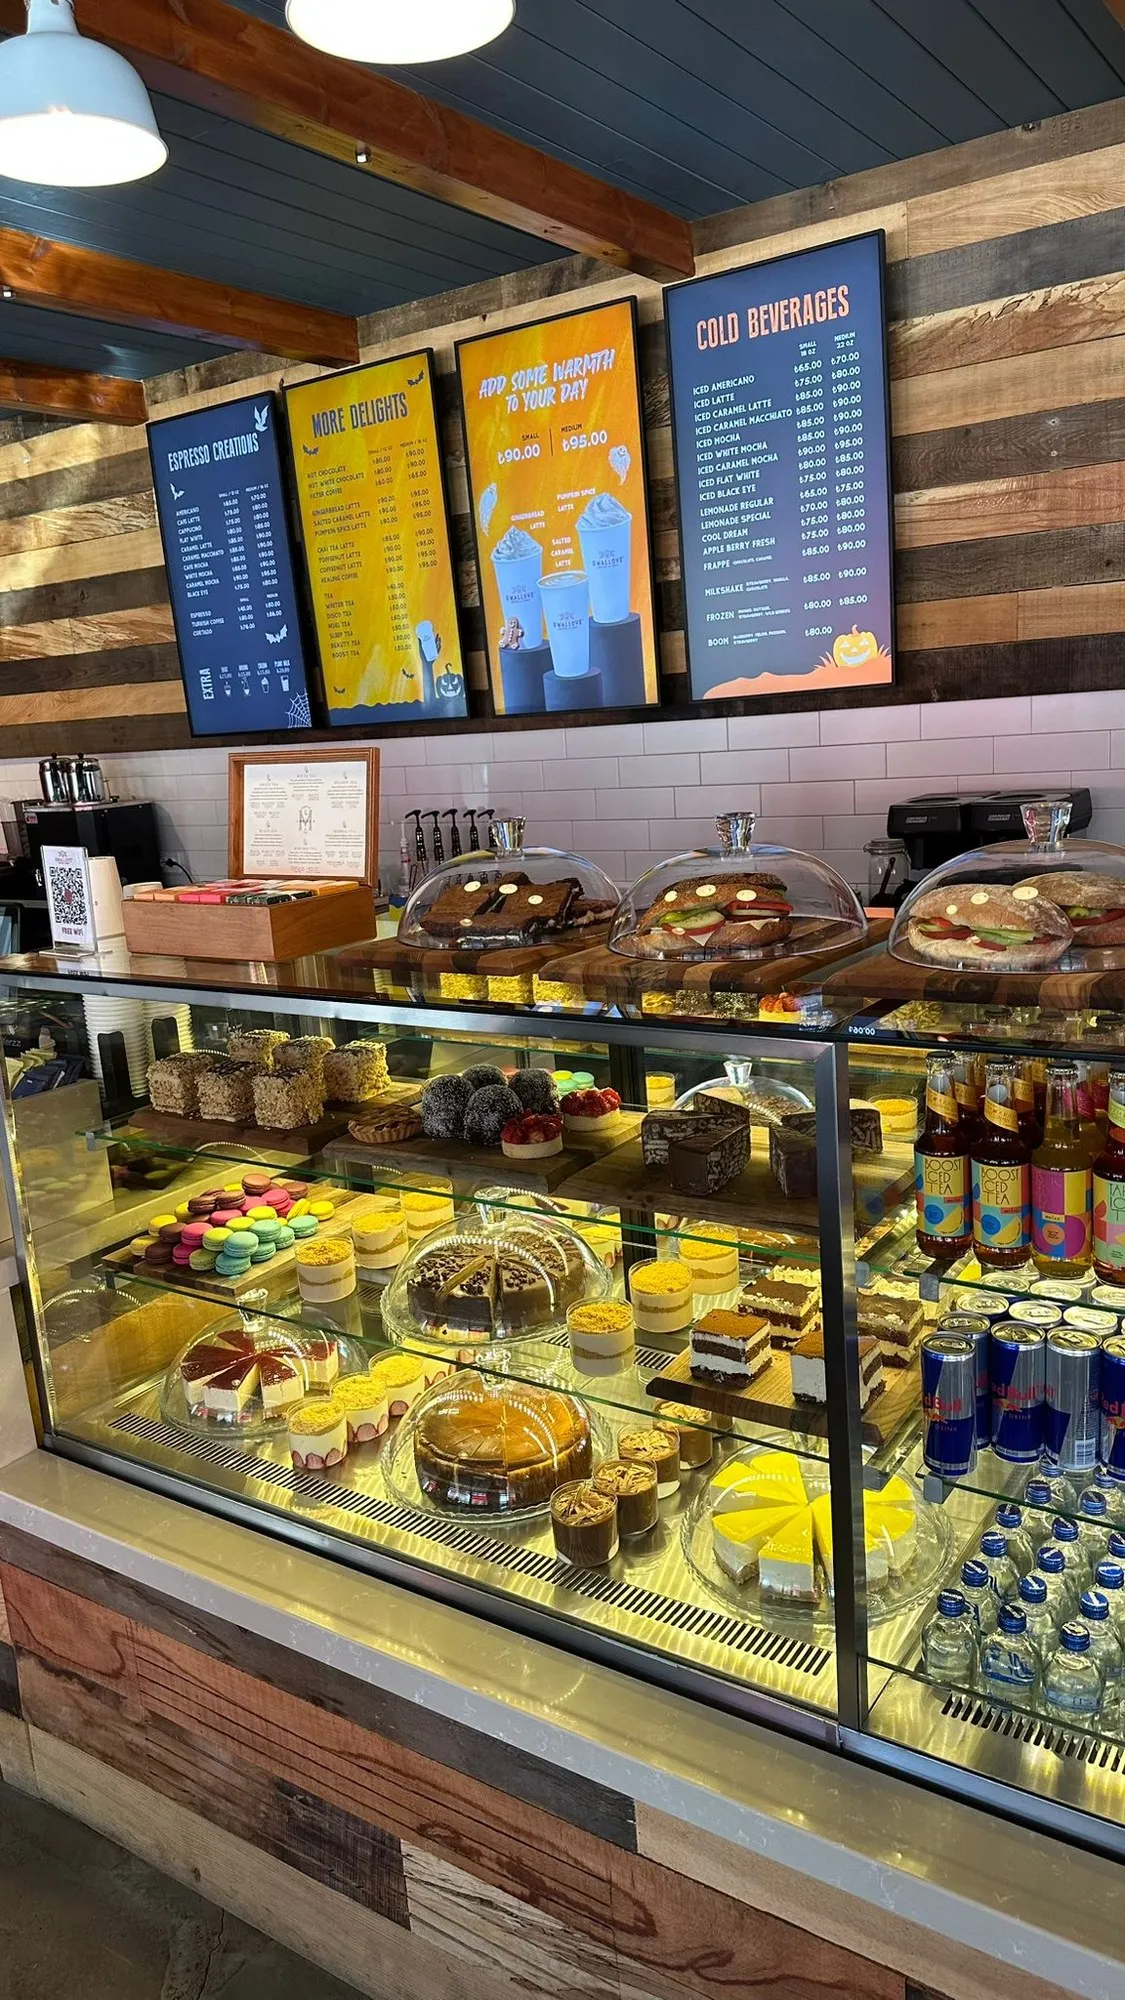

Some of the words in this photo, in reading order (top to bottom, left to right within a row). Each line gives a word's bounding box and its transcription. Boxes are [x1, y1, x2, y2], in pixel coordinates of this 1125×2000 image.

[696, 313, 738, 349] COLD
[748, 285, 849, 338] BEVERAGES
[479, 375, 506, 398] ADD
[511, 364, 548, 391] SOME
[552, 348, 615, 382] WARMTH
[692, 384, 709, 395] ICED
[711, 375, 754, 391] AMERICANO
[794, 359, 822, 373] ₺65.00
[830, 351, 859, 365] ₺70.00
[693, 398, 710, 408] ICED
[711, 392, 734, 405] LATTE
[794, 374, 822, 387] ₺75.00
[831, 366, 860, 379] ₺80.00
[505, 394, 518, 412] TO
[522, 386, 556, 411] YOUR
[560, 378, 588, 403] DAY
[694, 411, 711, 422] ICED
[712, 404, 746, 418] CARAMEL
[748, 398, 771, 410] LATTE
[795, 388, 823, 401] ₺85.00
[832, 380, 860, 393] ₺90.00
[311, 407, 345, 437] MORE
[349, 392, 407, 429] DELIGHTS
[560, 422, 582, 433] MEDIUM
[695, 425, 711, 435] ICED
[713, 418, 747, 431] CARAMEL
[748, 408, 792, 424] MACCHIATO
[796, 402, 823, 414] ₺85.00
[832, 394, 861, 407] ₺90.00
[696, 438, 712, 448] ICED
[714, 432, 740, 445] MOCHA
[796, 416, 824, 428] ₺85.00
[833, 408, 862, 421] ₺90.00
[168, 444, 210, 471] ESPRESSO
[212, 432, 259, 460] CREATIONS
[521, 431, 539, 441] SMALL
[562, 430, 607, 451] ₺95.00
[696, 452, 713, 461] ICED
[715, 446, 738, 458] WHITE
[740, 441, 767, 453] MOCHA
[797, 430, 824, 442] ₺85.00
[833, 422, 862, 435] ₺90.00
[497, 443, 540, 464] ₺90.00
[697, 465, 714, 475] ICED
[715, 458, 749, 471] CARAMEL
[751, 453, 778, 465] MOCHA
[797, 444, 825, 456] ₺90.00
[834, 436, 863, 449] ₺95.00
[698, 478, 714, 488] ICED
[716, 474, 733, 484] FLAT
[735, 469, 759, 480] WHITE
[798, 457, 826, 469] ₺80.00
[835, 451, 863, 463] ₺85.00
[699, 491, 715, 501] ICED
[717, 486, 740, 498] BLACK
[742, 484, 756, 493] EYE
[799, 471, 826, 483] ₺75.00
[835, 464, 864, 477] ₺80.00
[580, 487, 596, 496] SPICE
[700, 503, 738, 516] LEMONADE
[740, 497, 773, 510] REGULAR
[799, 487, 827, 498] ₺65.00
[835, 480, 863, 492] ₺75.00
[557, 503, 574, 512] LATTE
[701, 516, 738, 529] LEMONADE
[740, 511, 771, 522] SPECIAL
[800, 500, 828, 512] ₺70.00
[835, 494, 864, 506] ₺80.00
[529, 521, 545, 530] LATTE
[551, 536, 571, 545] SALTED
[701, 532, 721, 542] COOL
[723, 528, 748, 539] DREAM
[800, 514, 828, 526] ₺75.00
[836, 508, 865, 520] ₺80.00
[702, 545, 724, 555] APPLE
[726, 540, 750, 551] BERRY
[752, 537, 775, 547] FRESH
[801, 528, 828, 540] ₺75.00
[836, 522, 865, 534] ₺80.00
[550, 548, 573, 557] CARAMEL
[555, 559, 571, 567] LATTE
[703, 559, 729, 570] FRAPPE
[802, 545, 829, 556] ₺85.00
[837, 539, 866, 551] ₺90.00
[705, 584, 743, 596] MILKSHAKE
[803, 572, 830, 583] ₺85.00
[838, 567, 866, 578] ₺90.00
[706, 611, 734, 621] FROZEN
[804, 599, 831, 609] ₺80.00
[839, 594, 867, 605] ₺85.00
[708, 637, 729, 646] BOOM
[804, 626, 832, 636] ₺80.00
[199, 668, 214, 700] EXTRA
[925, 1158, 961, 1172] BOOST
[925, 1171, 951, 1183] ICED
[981, 1166, 1020, 1181] BOOST
[925, 1182, 953, 1195] TEA
[982, 1180, 1008, 1193] ICED
[982, 1191, 1010, 1205] TEA
